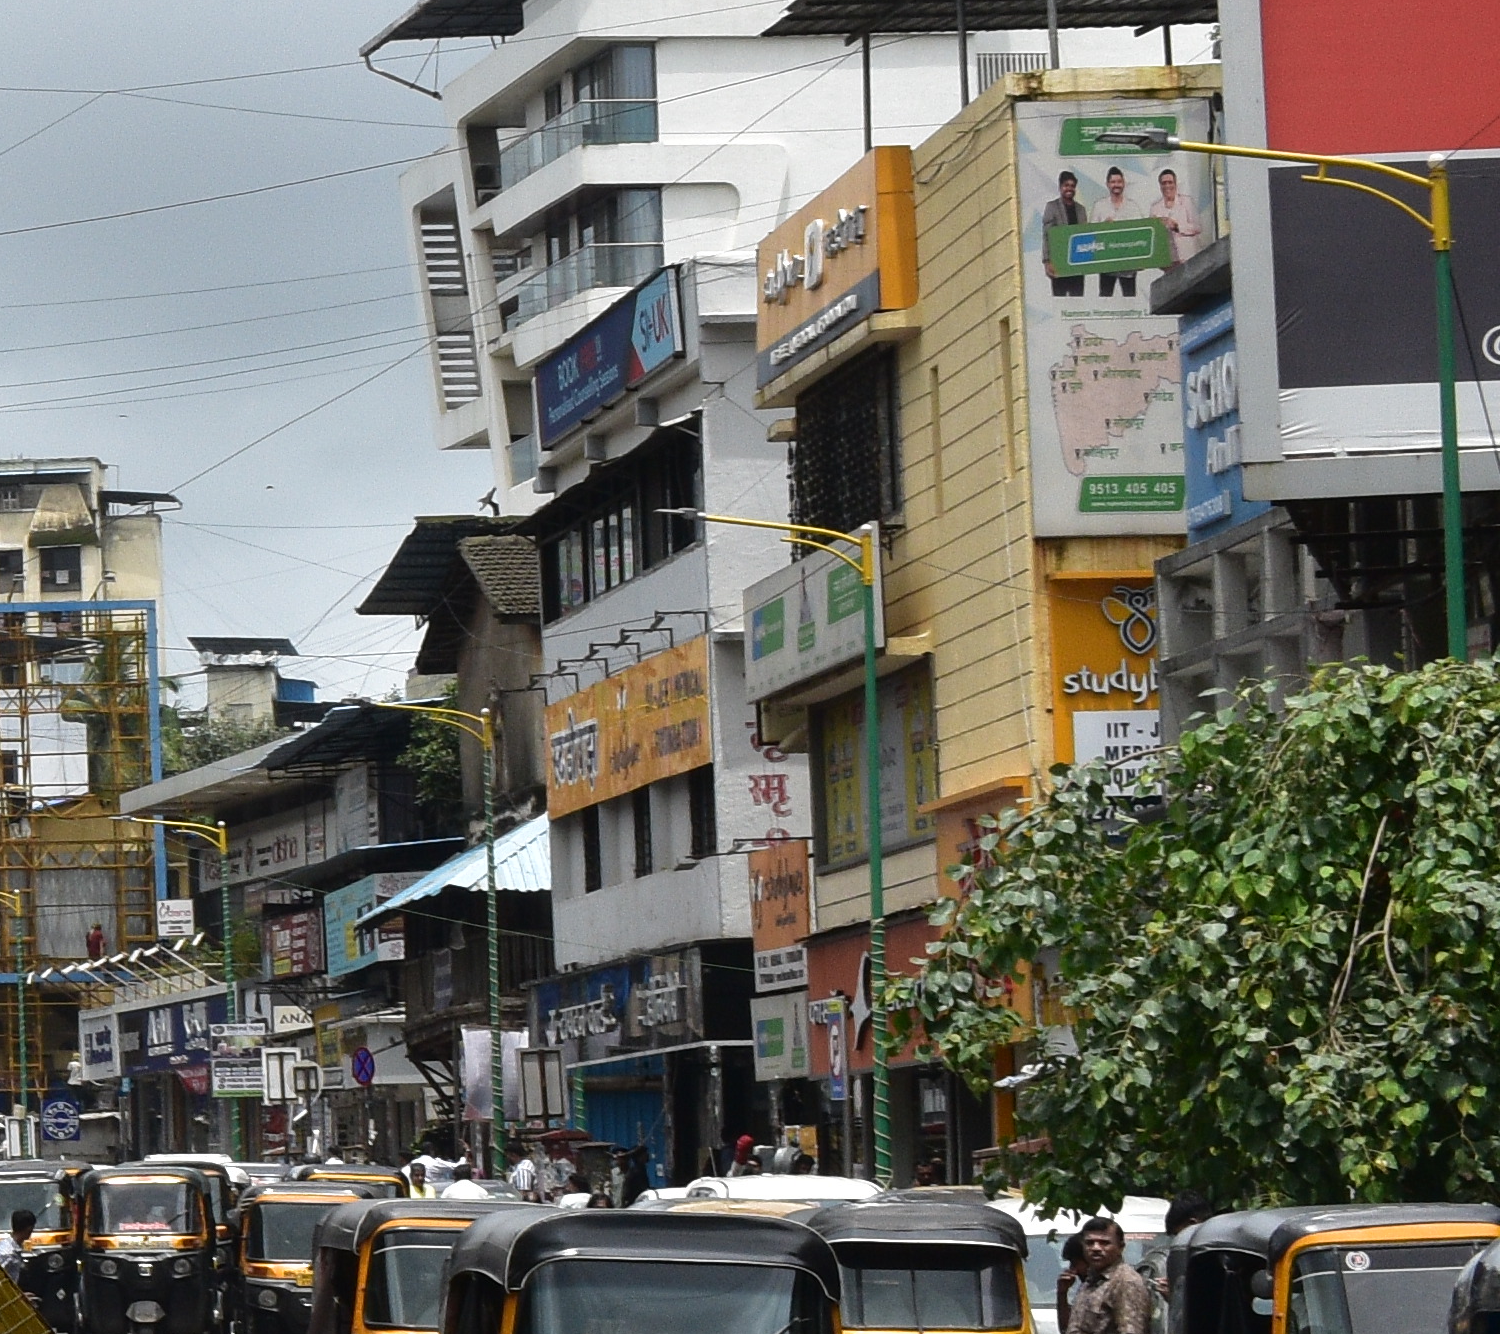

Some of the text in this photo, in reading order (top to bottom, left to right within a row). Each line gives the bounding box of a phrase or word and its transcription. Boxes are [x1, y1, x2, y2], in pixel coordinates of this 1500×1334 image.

[1089, 482, 1177, 495] 9513 405 405
[1106, 722, 1130, 738] IIT
